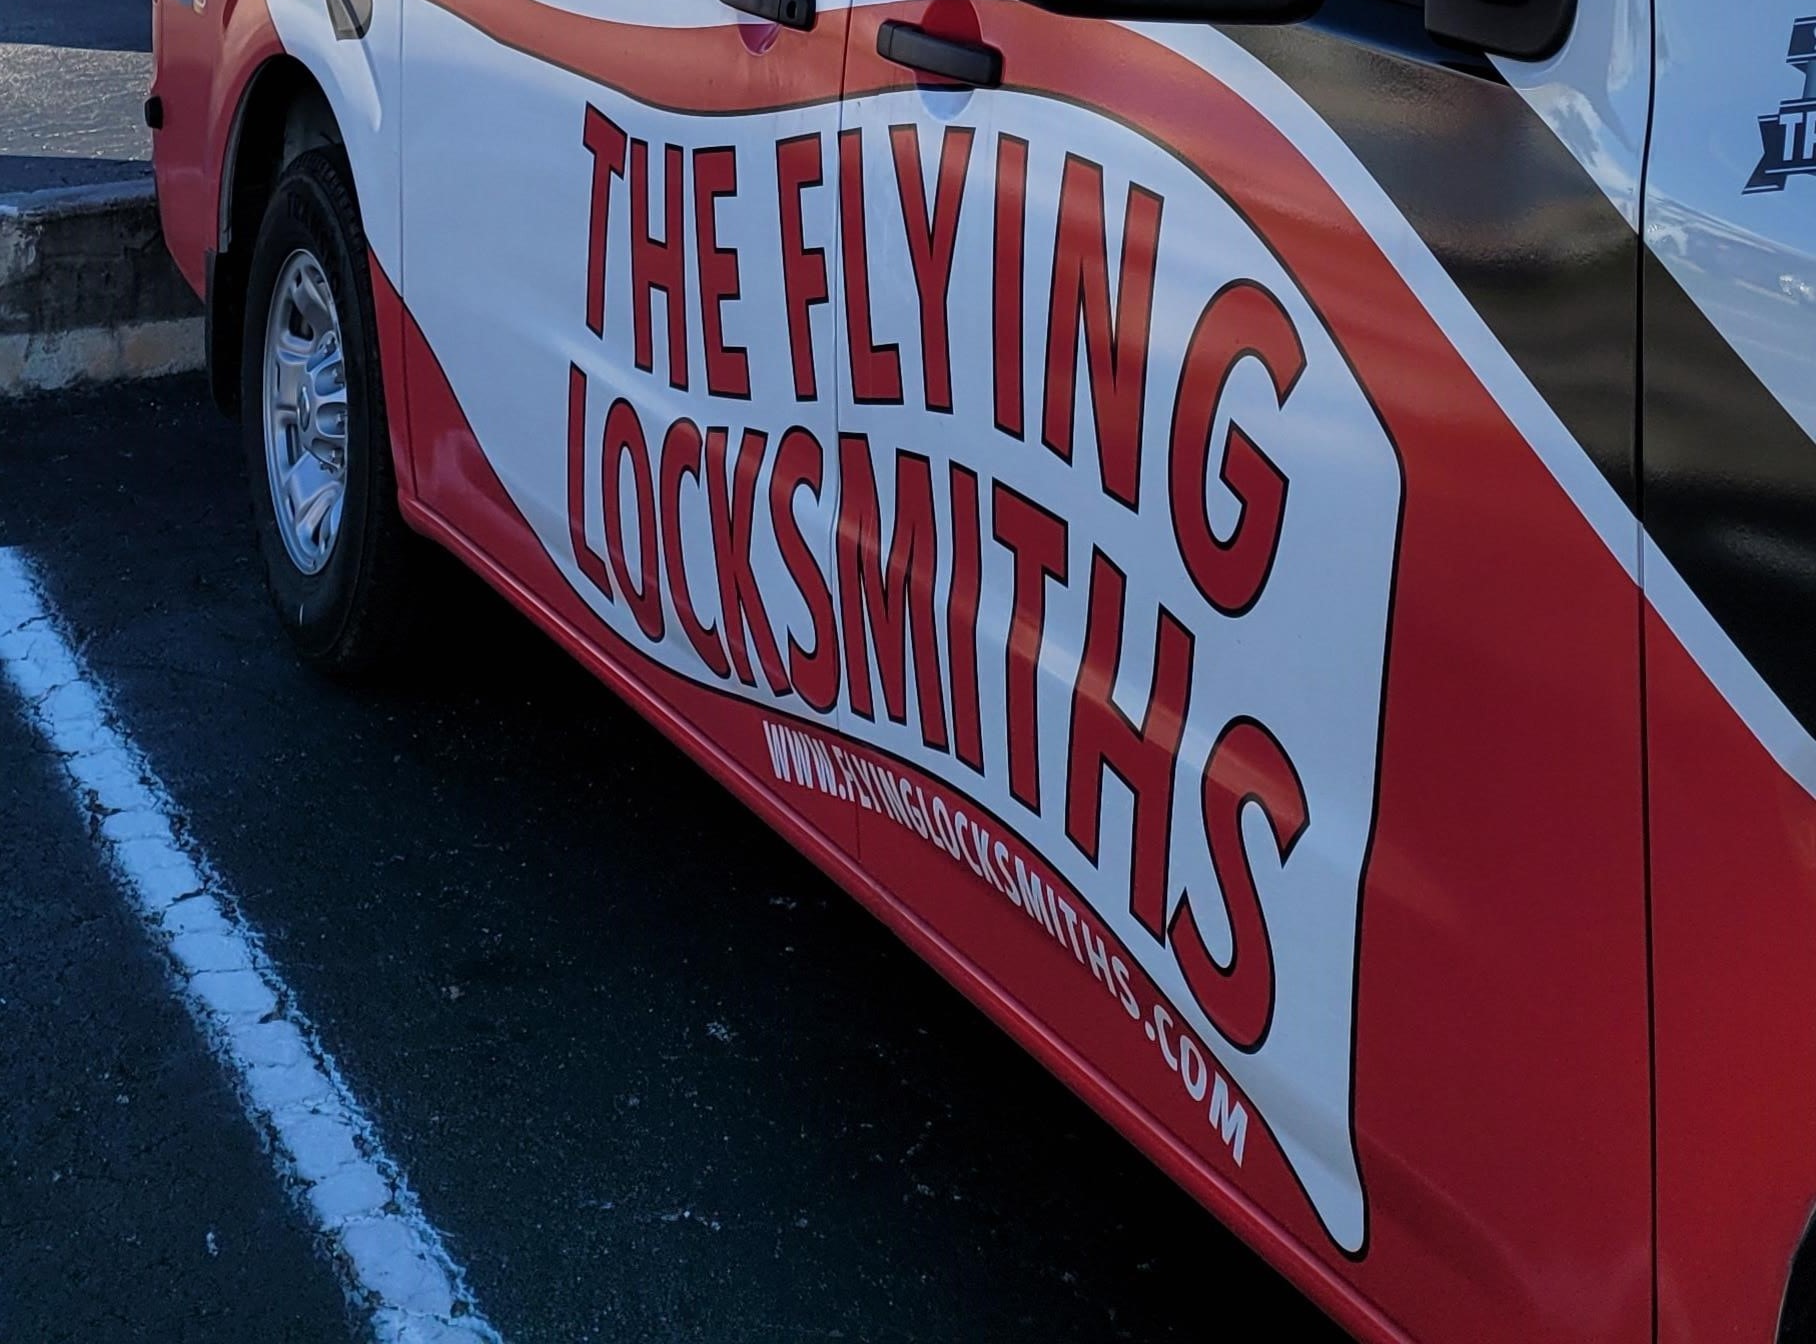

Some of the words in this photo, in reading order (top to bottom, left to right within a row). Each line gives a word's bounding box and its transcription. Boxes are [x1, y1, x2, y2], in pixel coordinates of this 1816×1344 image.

[584, 102, 750, 400] THE
[775, 123, 1307, 618] FLYING
[567, 361, 1311, 1054] LOCKSMITHS
[762, 719, 1249, 1169] WWW.FLYINGLOCKSMITHS.COM
